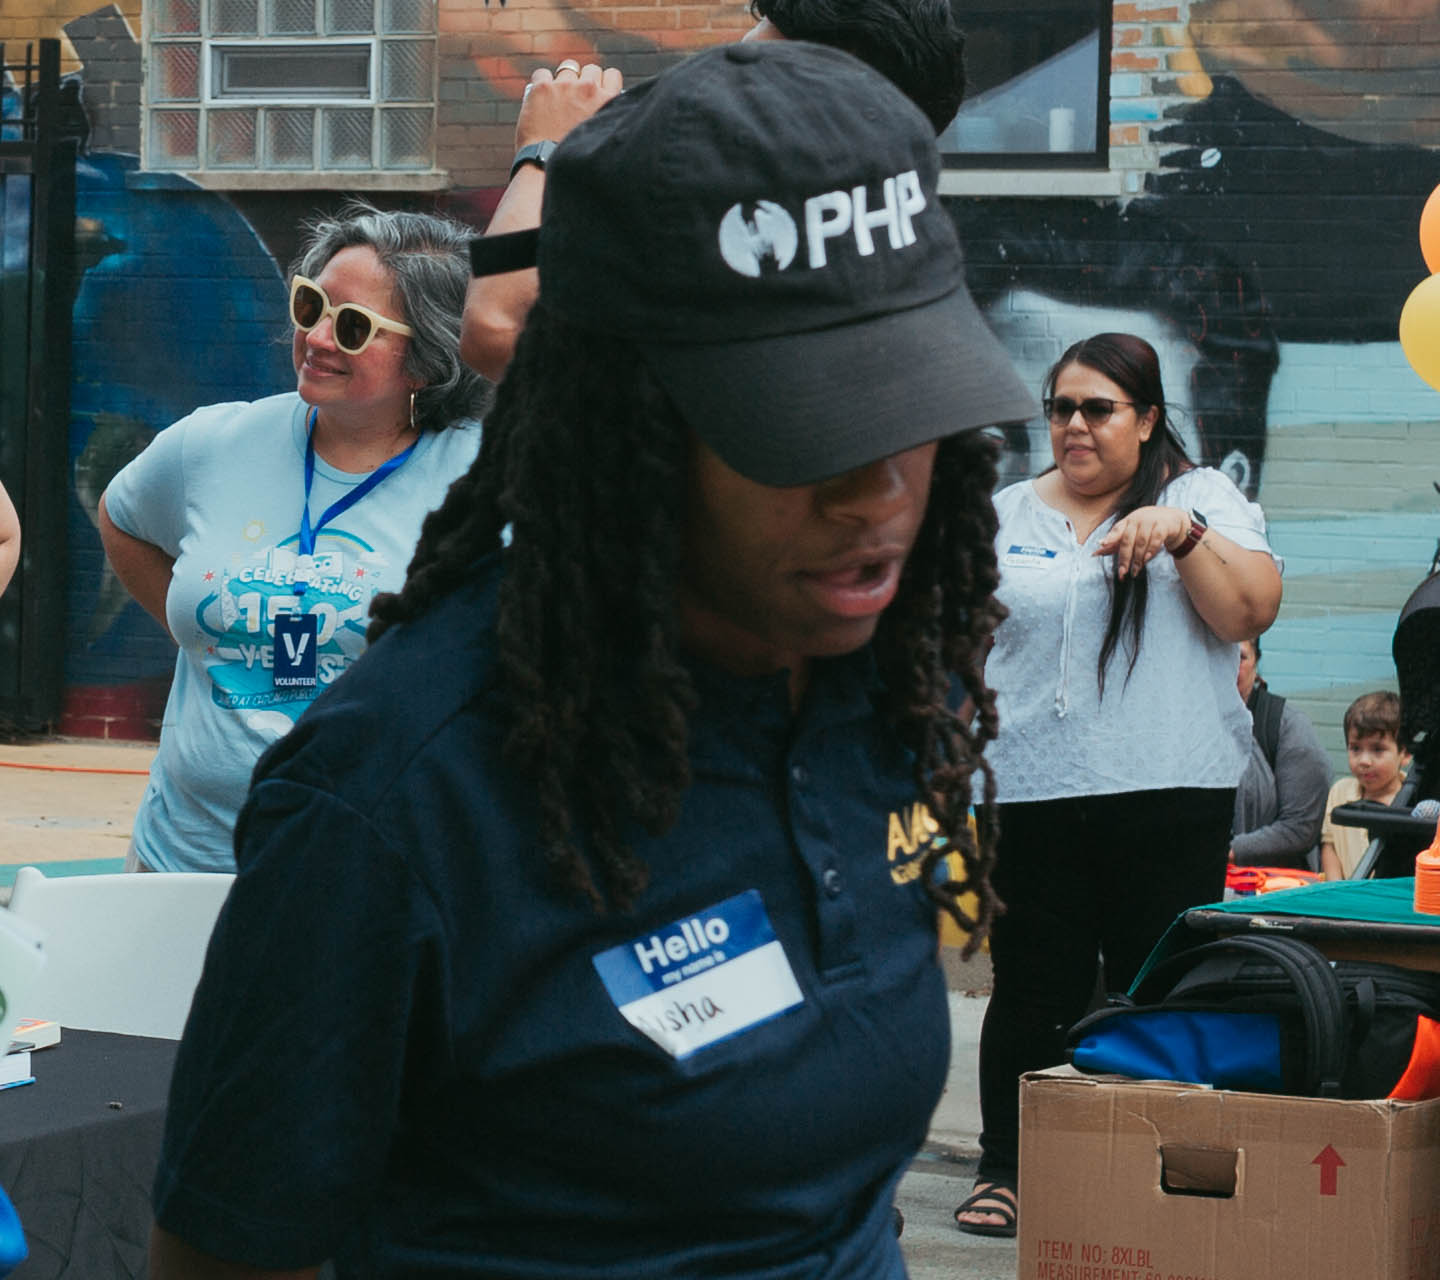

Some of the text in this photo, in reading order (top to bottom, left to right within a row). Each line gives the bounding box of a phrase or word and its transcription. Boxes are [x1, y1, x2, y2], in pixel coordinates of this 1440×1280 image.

[805, 170, 927, 270] PHP
[238, 591, 339, 646] 150
[239, 644, 337, 684] YES
[275, 677, 316, 686] VOLUNTEER
[634, 918, 729, 974] Hello
[1038, 1240, 1153, 1269] ITEM NO: 8XLBL
